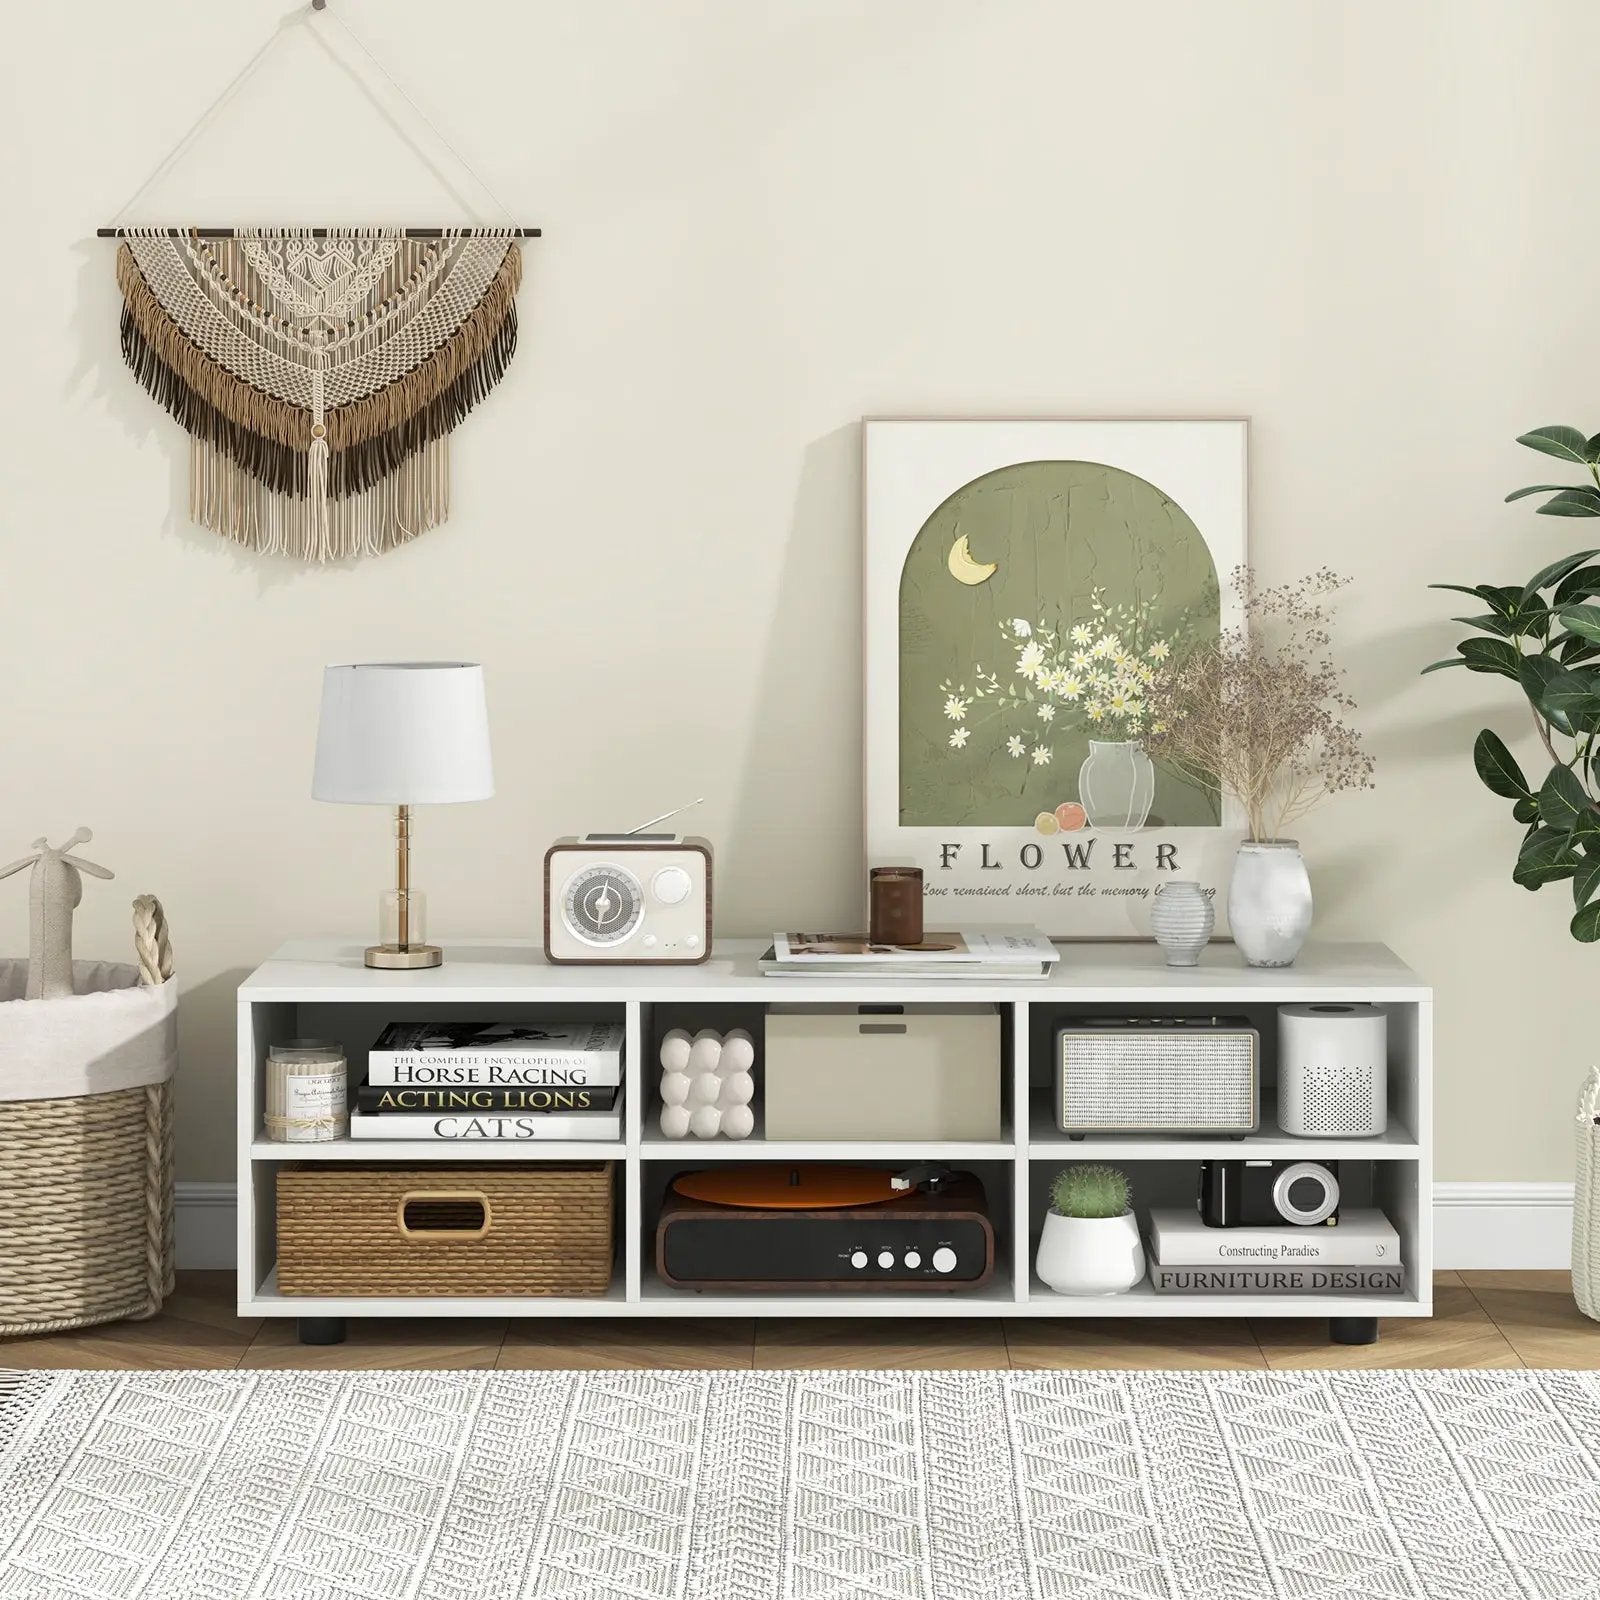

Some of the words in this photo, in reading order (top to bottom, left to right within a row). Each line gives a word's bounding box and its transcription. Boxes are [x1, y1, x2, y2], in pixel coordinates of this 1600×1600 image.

[940, 840, 1181, 872] FLOWER
[922, 883, 948, 896] Love
[953, 886, 1012, 896] remained
[1077, 883, 1097, 896] the
[1101, 887, 1150, 900] memory
[394, 1056, 416, 1065] THE
[419, 1056, 480, 1065] COMPLETE
[484, 1056, 569, 1065] ENCYCLOPEDIA
[378, 1090, 493, 1109] ACTING
[503, 1090, 591, 1108] LIONS
[434, 1117, 535, 1139] CATS
[1218, 1244, 1279, 1260] Constructing
[1280, 1244, 1320, 1257] Paradies
[1160, 1273, 1304, 1289] FURNITURE
[1312, 1273, 1403, 1289] DESIGN
